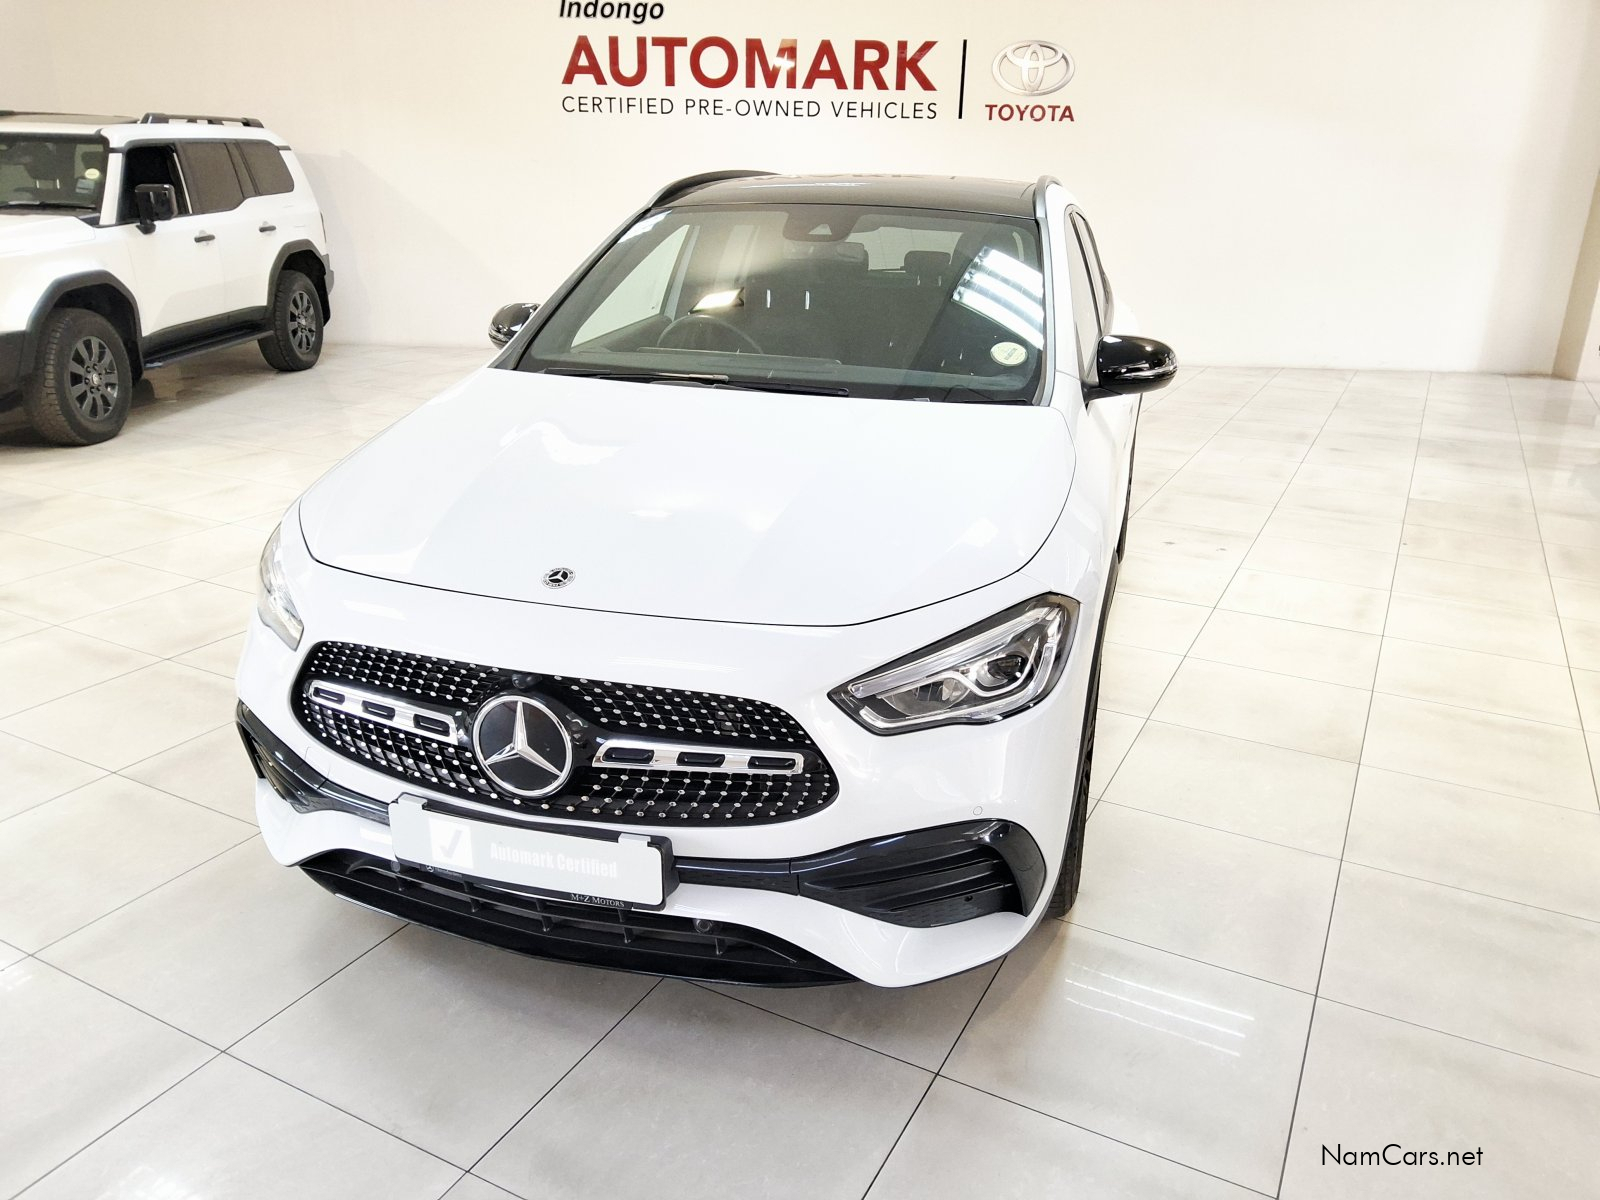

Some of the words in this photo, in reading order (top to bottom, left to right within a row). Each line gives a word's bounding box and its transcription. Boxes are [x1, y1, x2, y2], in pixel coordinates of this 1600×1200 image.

[561, 35, 939, 91] AUTOMARK
[561, 95, 674, 115] CERTIFIED
[685, 99, 822, 118] PRE-OWNED
[831, 101, 937, 120] VEHICLES
[985, 104, 1075, 122] TOYOTA
[490, 842, 554, 871] Automark
[557, 854, 617, 878] Certified
